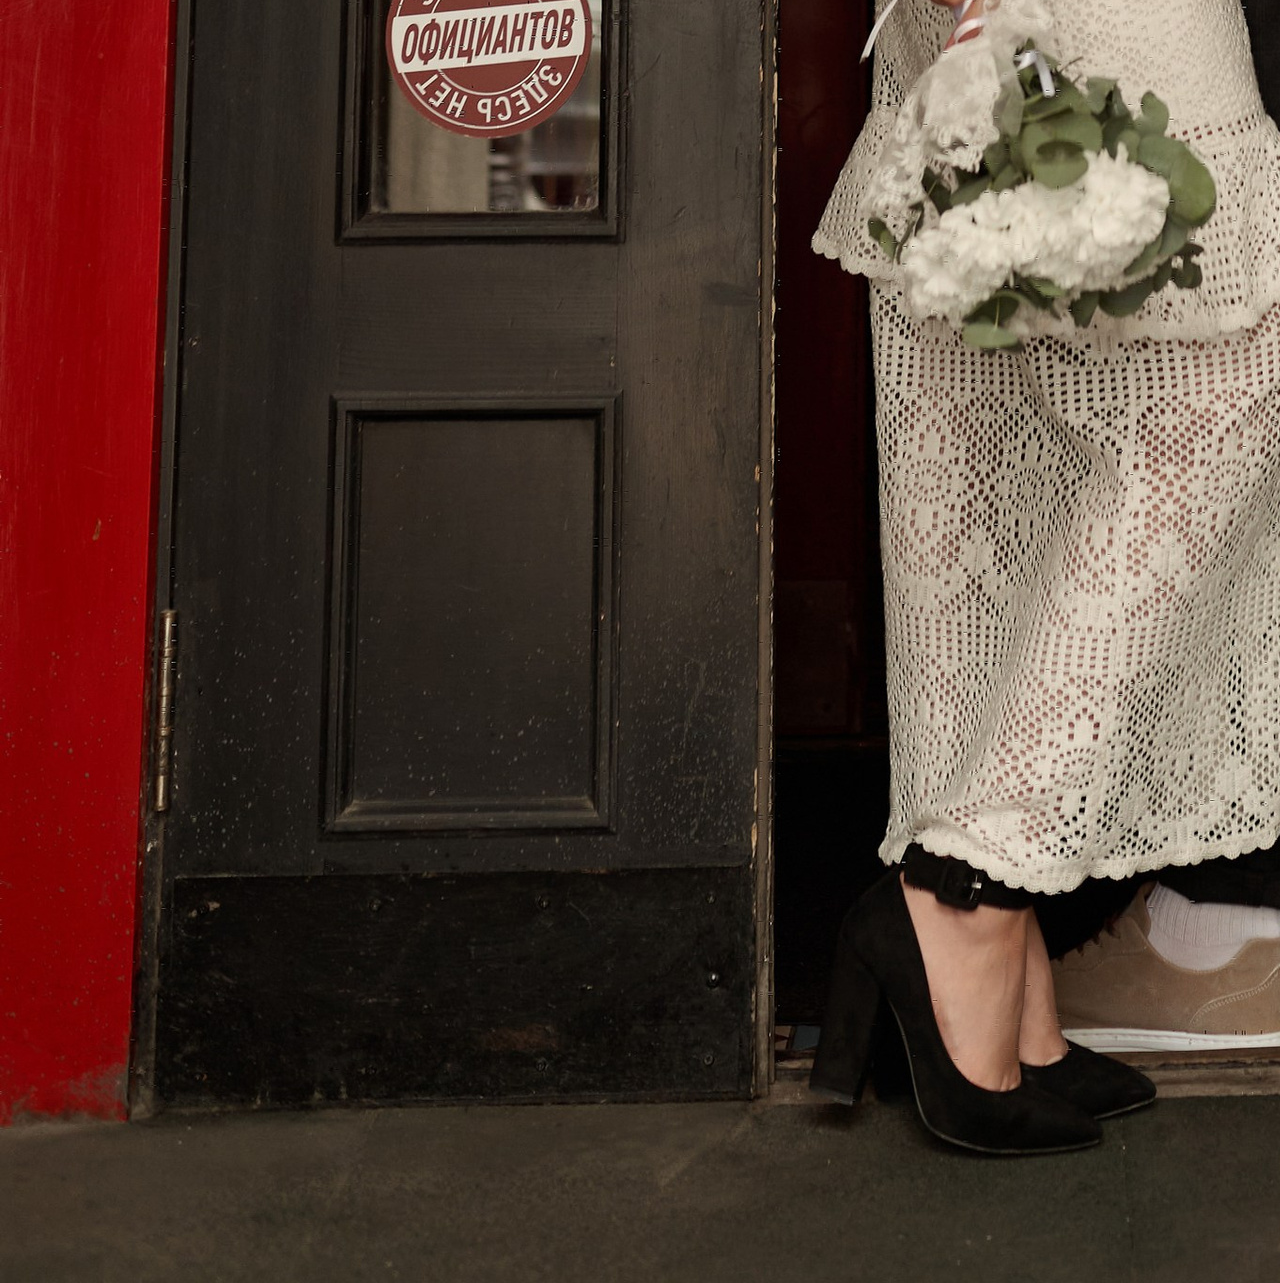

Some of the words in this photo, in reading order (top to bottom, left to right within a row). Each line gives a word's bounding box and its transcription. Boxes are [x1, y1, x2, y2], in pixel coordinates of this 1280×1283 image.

[401, 8, 576, 66] ОФИЦИАНТОВ
[415, 73, 468, 118] НЕТ
[477, 64, 563, 123] ЗДЕСЬ
